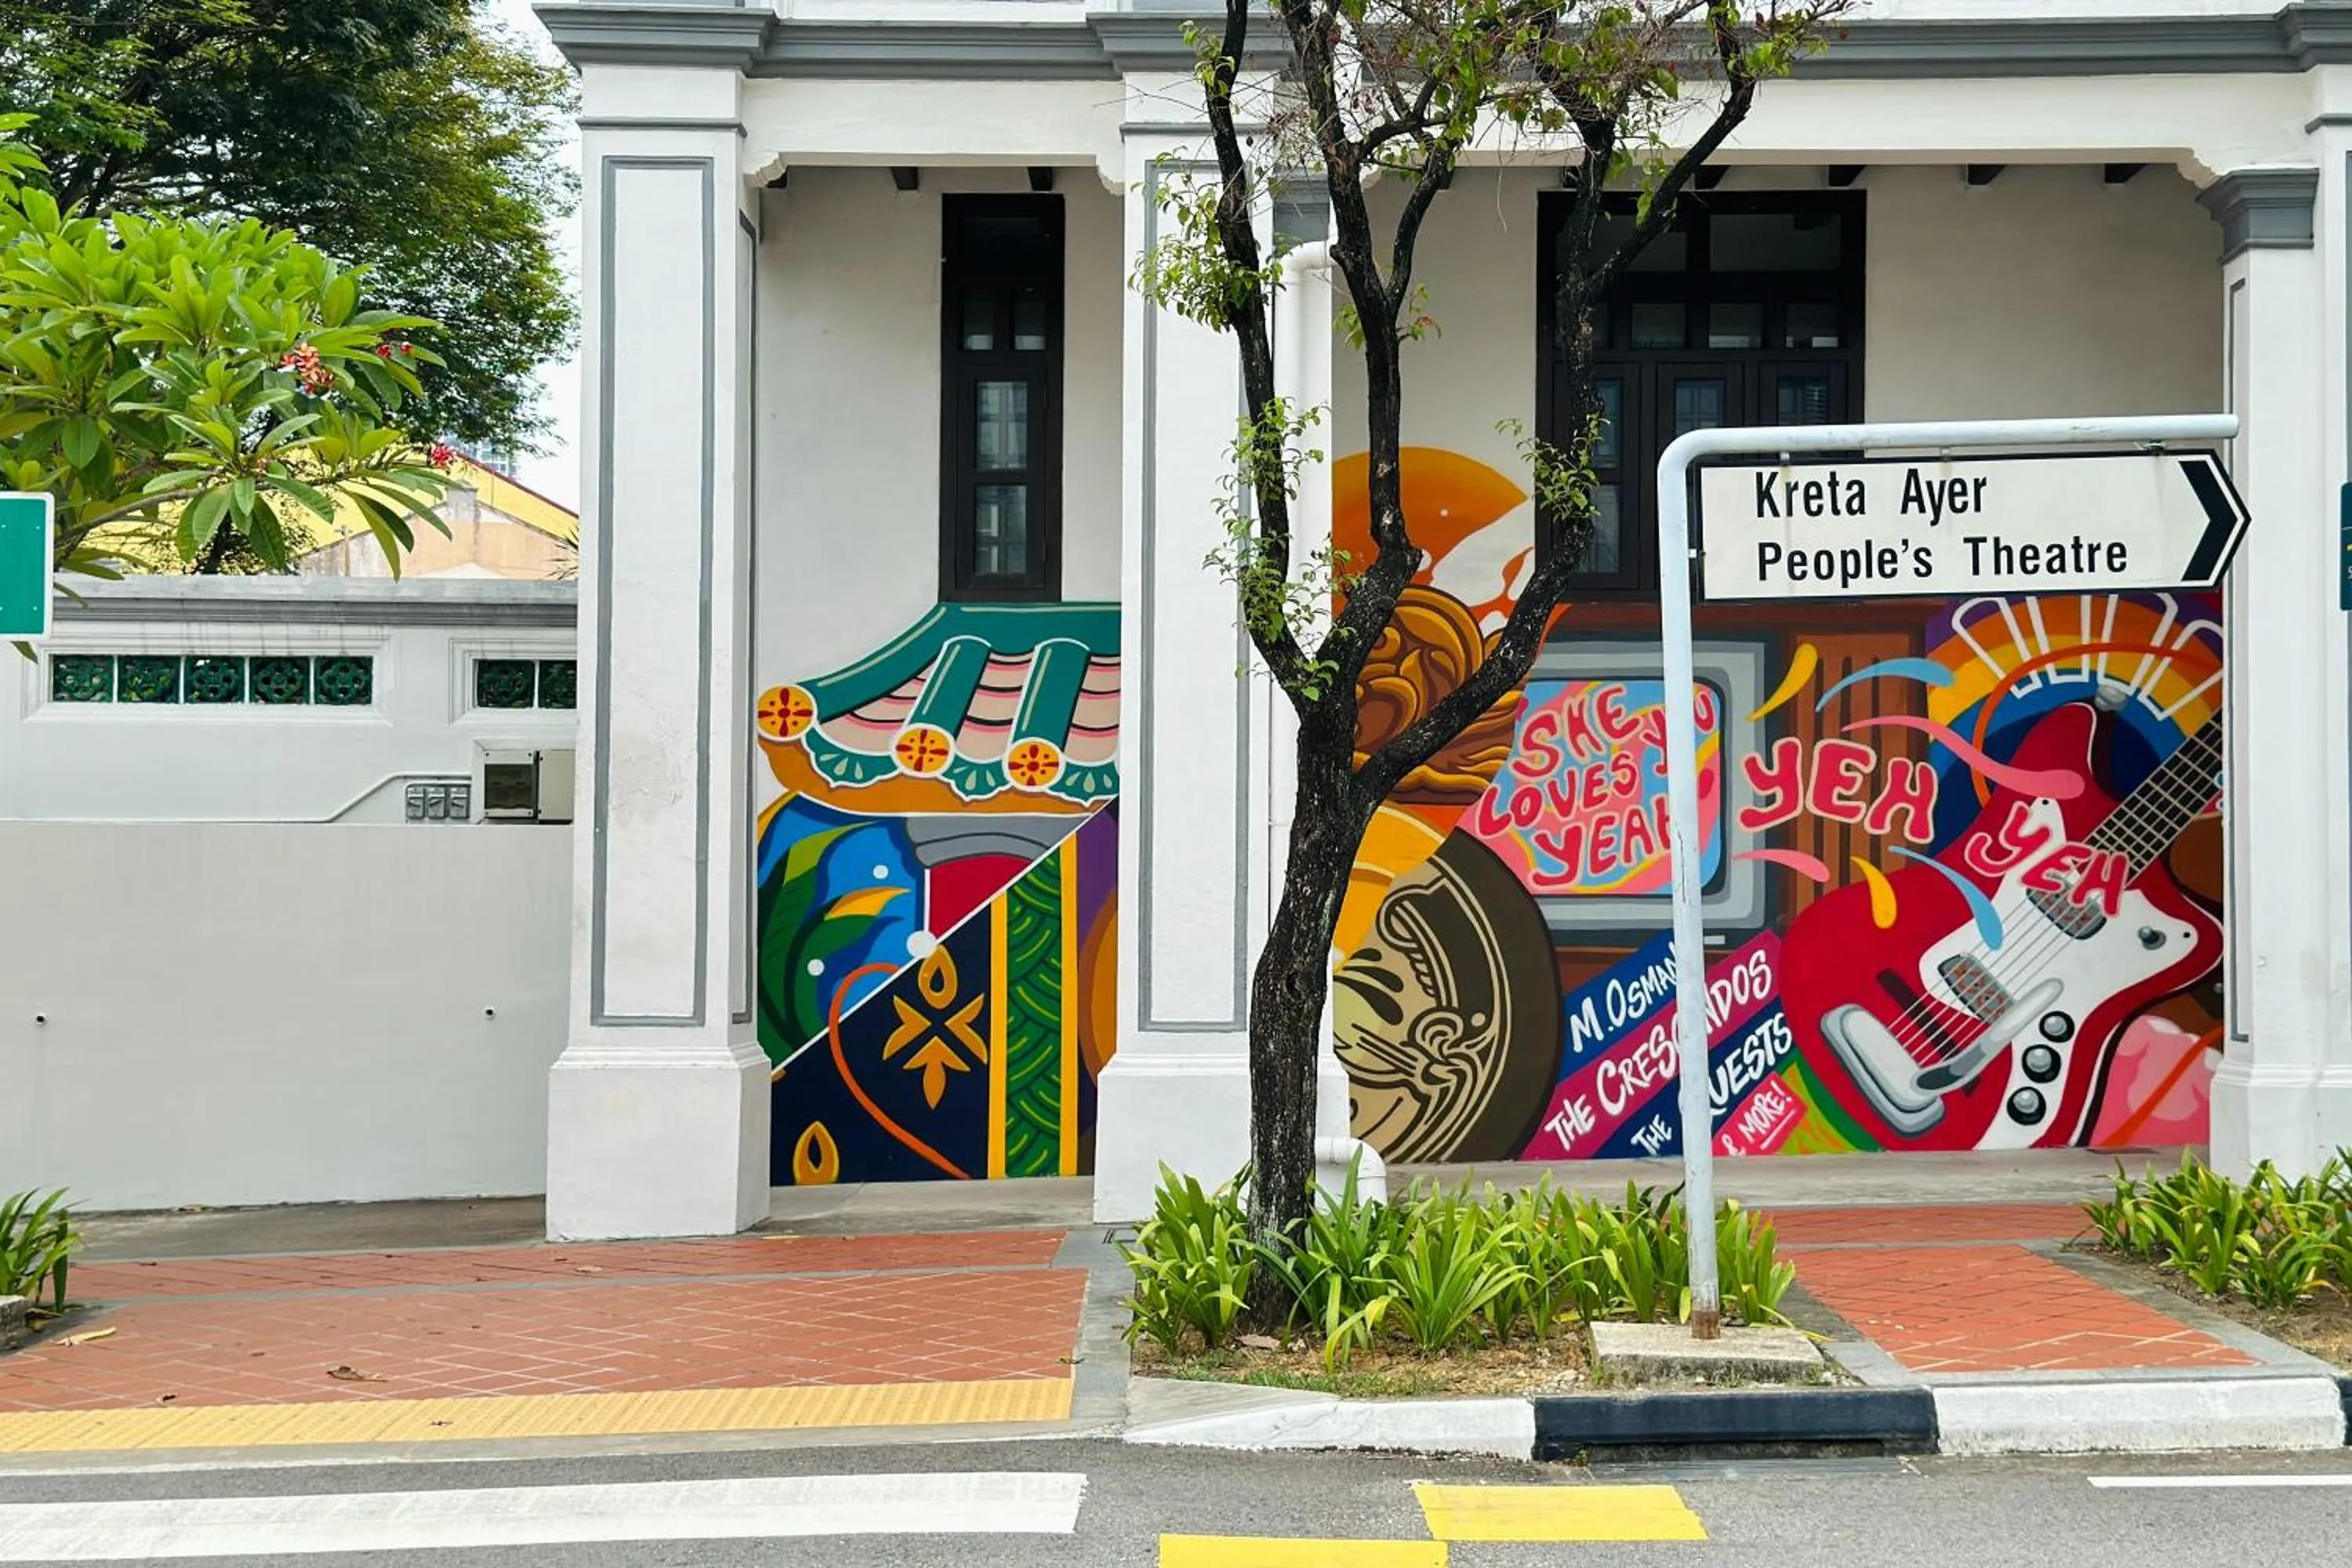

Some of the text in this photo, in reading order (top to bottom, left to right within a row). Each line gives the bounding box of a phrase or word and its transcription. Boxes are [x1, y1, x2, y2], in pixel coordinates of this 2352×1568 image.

[1755, 468, 1987, 527] Kreta Ayer
[1758, 535, 2128, 589] People's Theatre
[1477, 690, 1716, 837] LOVES YU
[1508, 684, 1642, 779] SHE
[1738, 737, 1939, 844] YEH
[1965, 800, 2131, 919] YEH
[1544, 949, 1772, 1151] THE CRESNDOS
[1631, 1012, 1793, 1156] THE UESTS
[1721, 1080, 1793, 1157] & MORE!
